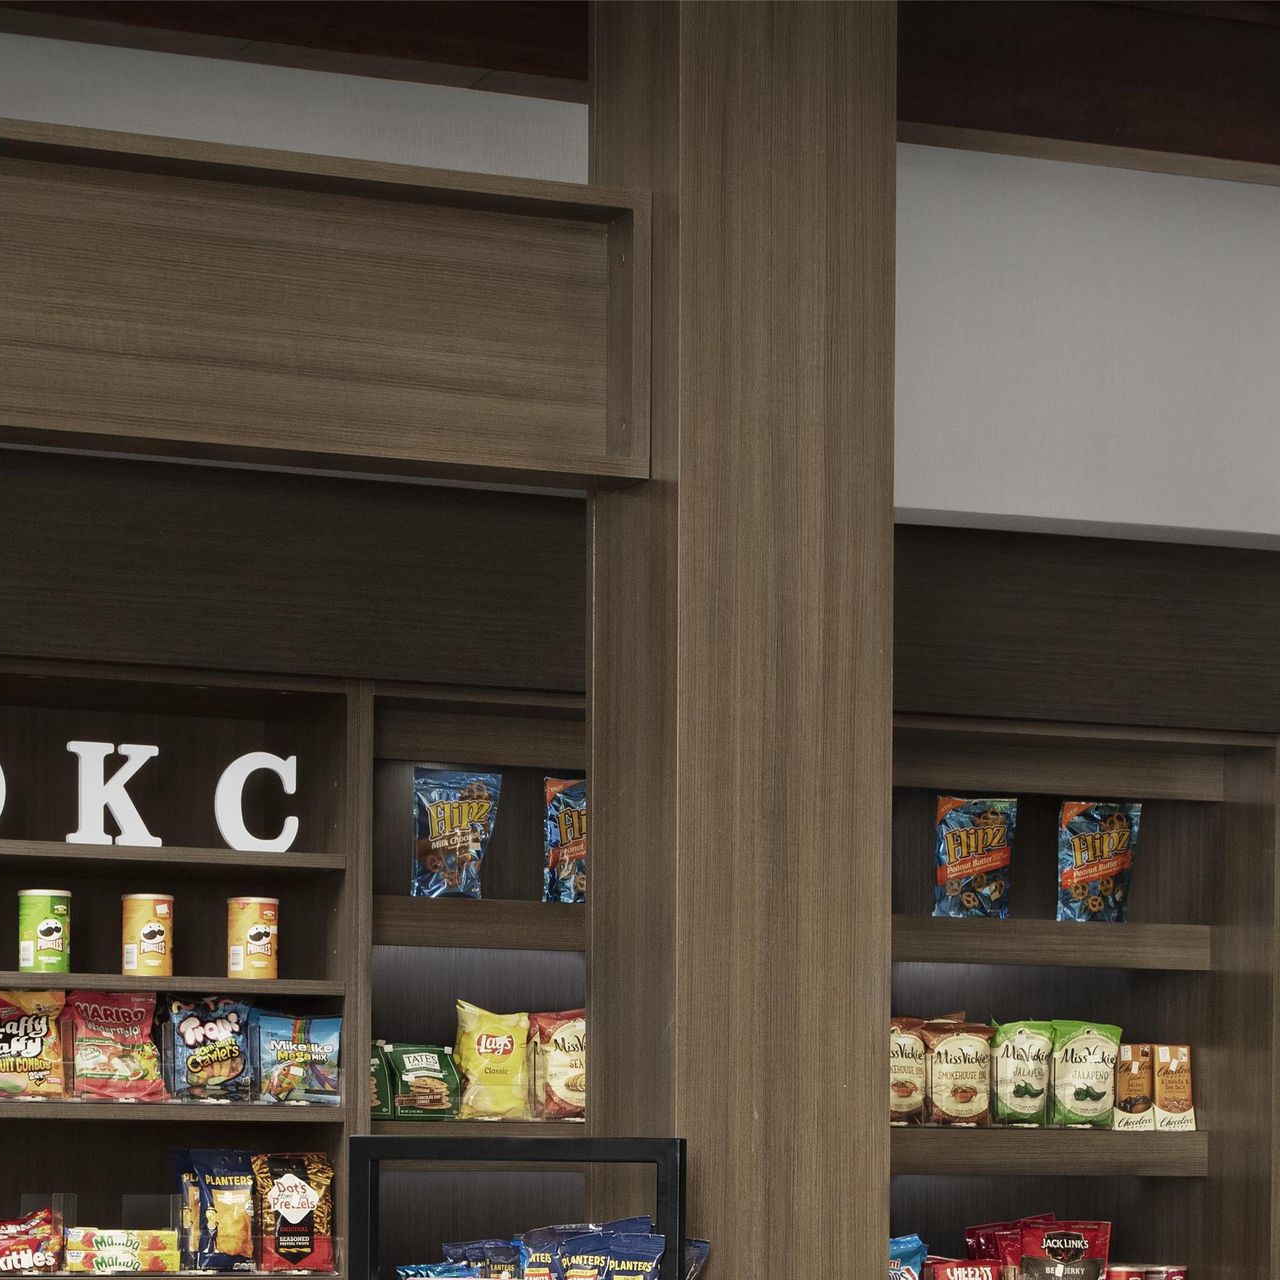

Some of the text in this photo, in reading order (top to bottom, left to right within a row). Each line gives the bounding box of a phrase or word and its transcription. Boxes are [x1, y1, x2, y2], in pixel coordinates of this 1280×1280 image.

[427, 800, 492, 841] Flipz
[556, 808, 586, 848] Fli
[944, 825, 1006, 865] Flipz
[1071, 829, 1130, 869] Flipz
[947, 856, 993, 875] Peanut Butter
[1073, 865, 1097, 878] Peanut
[76, 1002, 145, 1025] HARIBO
[270, 1039, 306, 1051] Mike
[186, 1045, 240, 1073] Crawlers
[276, 1051, 328, 1063] Mega MIX
[405, 1054, 438, 1065] TATE'S
[15, 1057, 52, 1072] COMBOS
[484, 1066, 509, 1076] Classic
[938, 1071, 977, 1080] SMOKEHOUSE
[205, 1174, 252, 1187] PLANTERS
[276, 1180, 307, 1194] Dot's
[1041, 1239, 1063, 1249] JACK
[562, 1254, 607, 1267] PLANTERS
[609, 1259, 653, 1271] PLANTERS
[1065, 1267, 1085, 1275] JERKY
